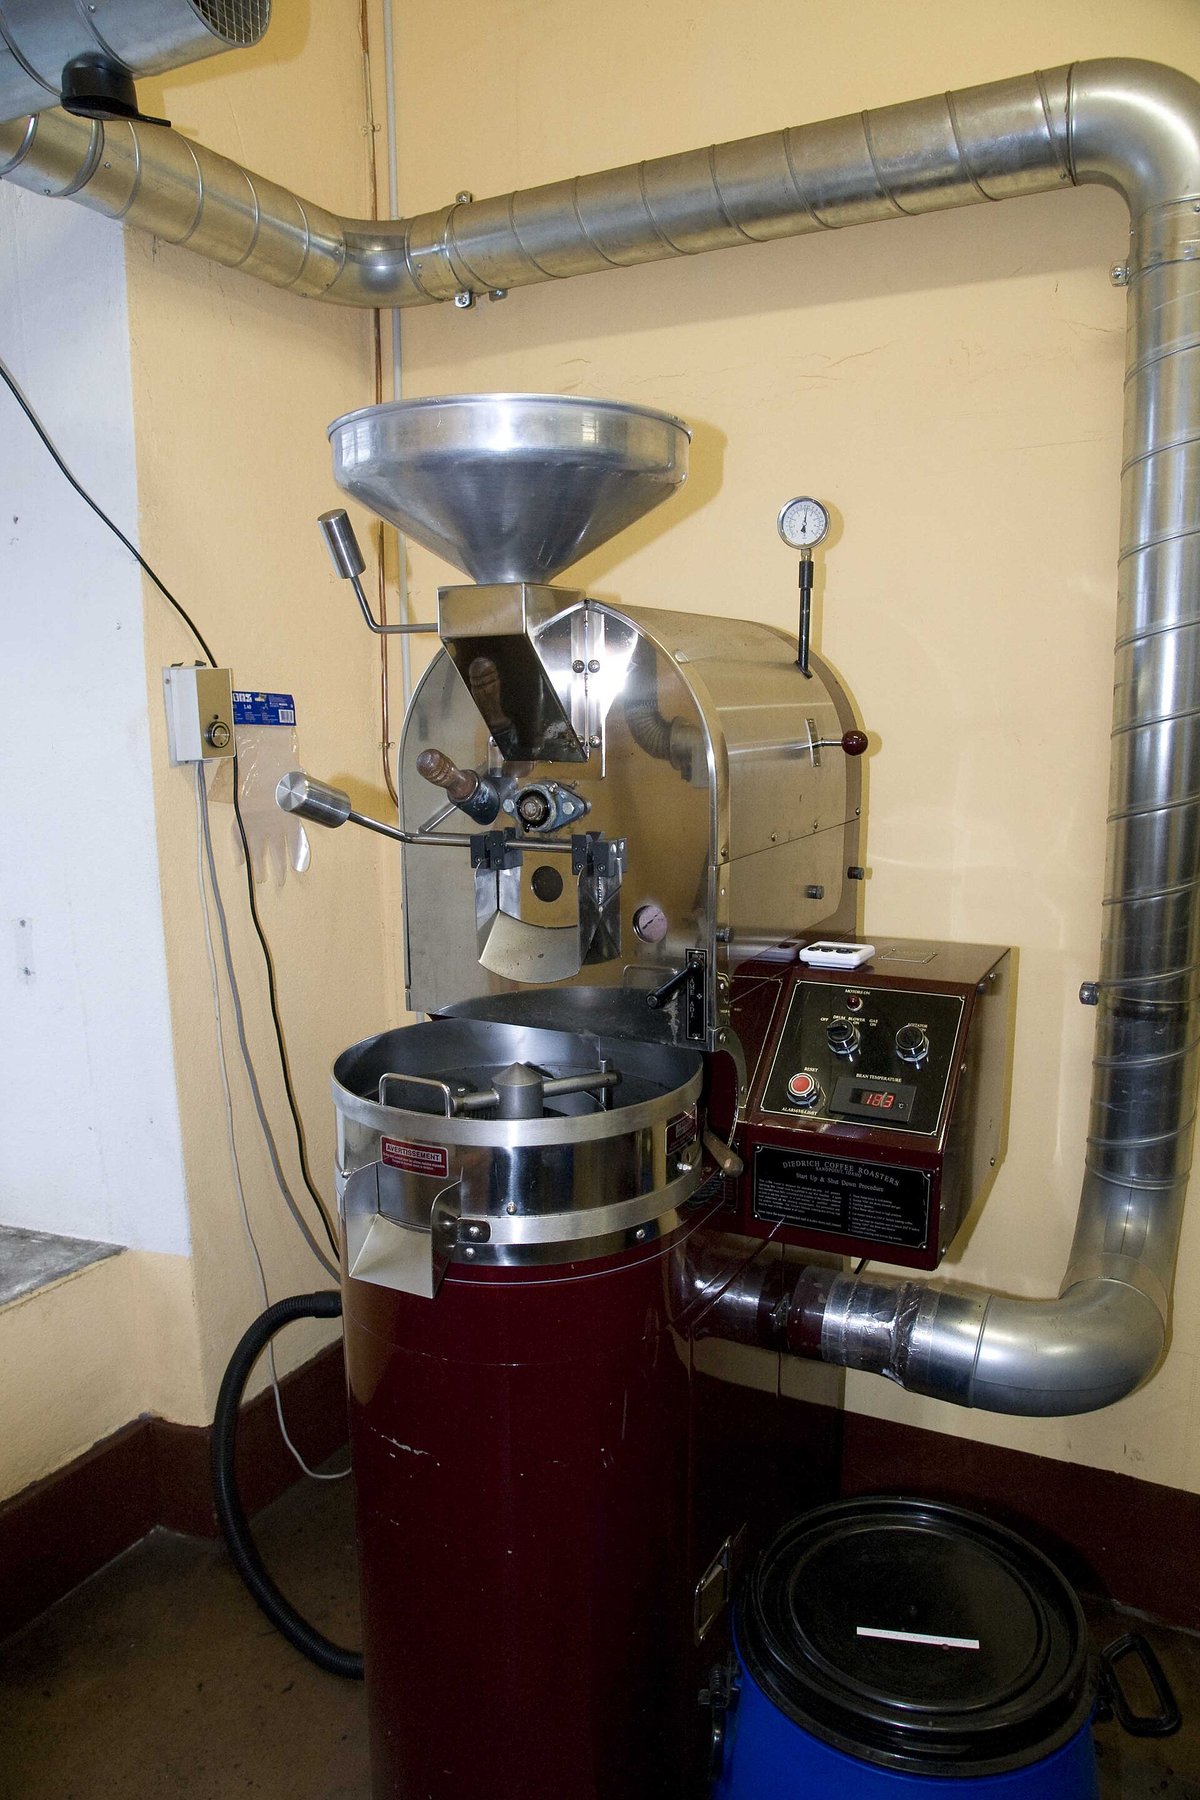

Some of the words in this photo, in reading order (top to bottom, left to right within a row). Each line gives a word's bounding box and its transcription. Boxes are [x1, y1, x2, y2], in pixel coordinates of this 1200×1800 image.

[869, 1074, 902, 1083] TEMPERATURE
[387, 1144, 440, 1161] AVERTISSEMENT
[782, 1160, 820, 1169] DIEDRICH
[824, 1161, 854, 1172] COFFEE
[858, 1167, 900, 1187] ROASTERS
[796, 1172, 808, 1180] Start
[809, 1174, 818, 1183] Up
[827, 1177, 839, 1185] Shut
[841, 1179, 857, 1188] Down
[858, 1182, 884, 1193] Procedure
